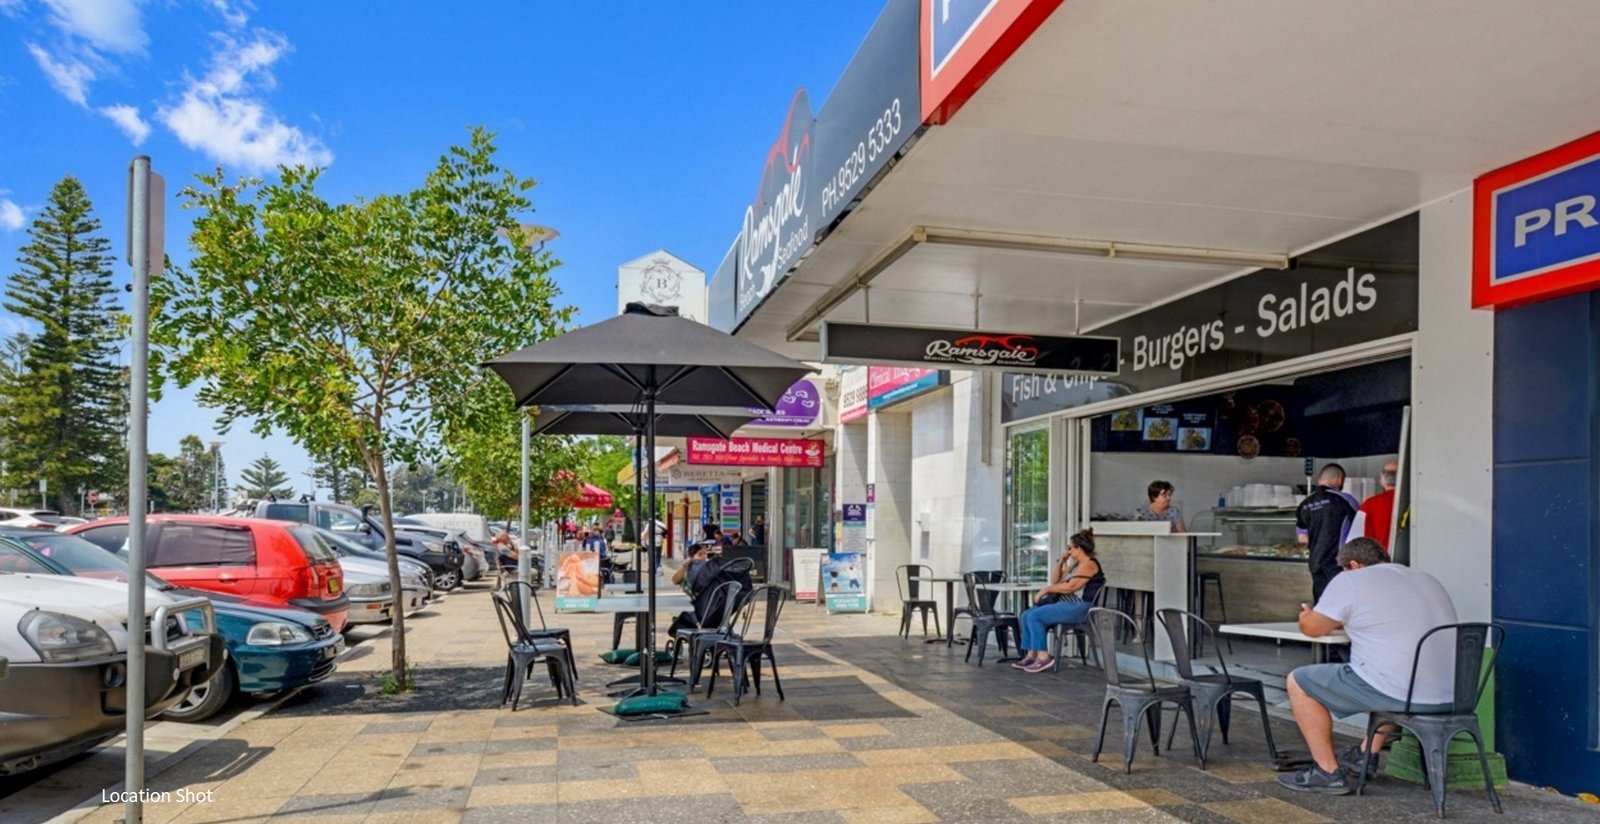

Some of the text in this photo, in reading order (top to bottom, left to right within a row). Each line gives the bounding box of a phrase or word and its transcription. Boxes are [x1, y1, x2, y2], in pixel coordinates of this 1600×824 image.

[821, 98, 902, 217] PH.9529 5333
[777, 214, 809, 270] Seafood
[1514, 194, 1600, 249] PR
[1012, 373, 1040, 403] Fish
[1133, 319, 1225, 371] Burgers
[1256, 267, 1378, 338] Salads
[996, 359, 1036, 367] Seafood
[692, 439, 803, 455] Ramsgate Beach Medical Centre
